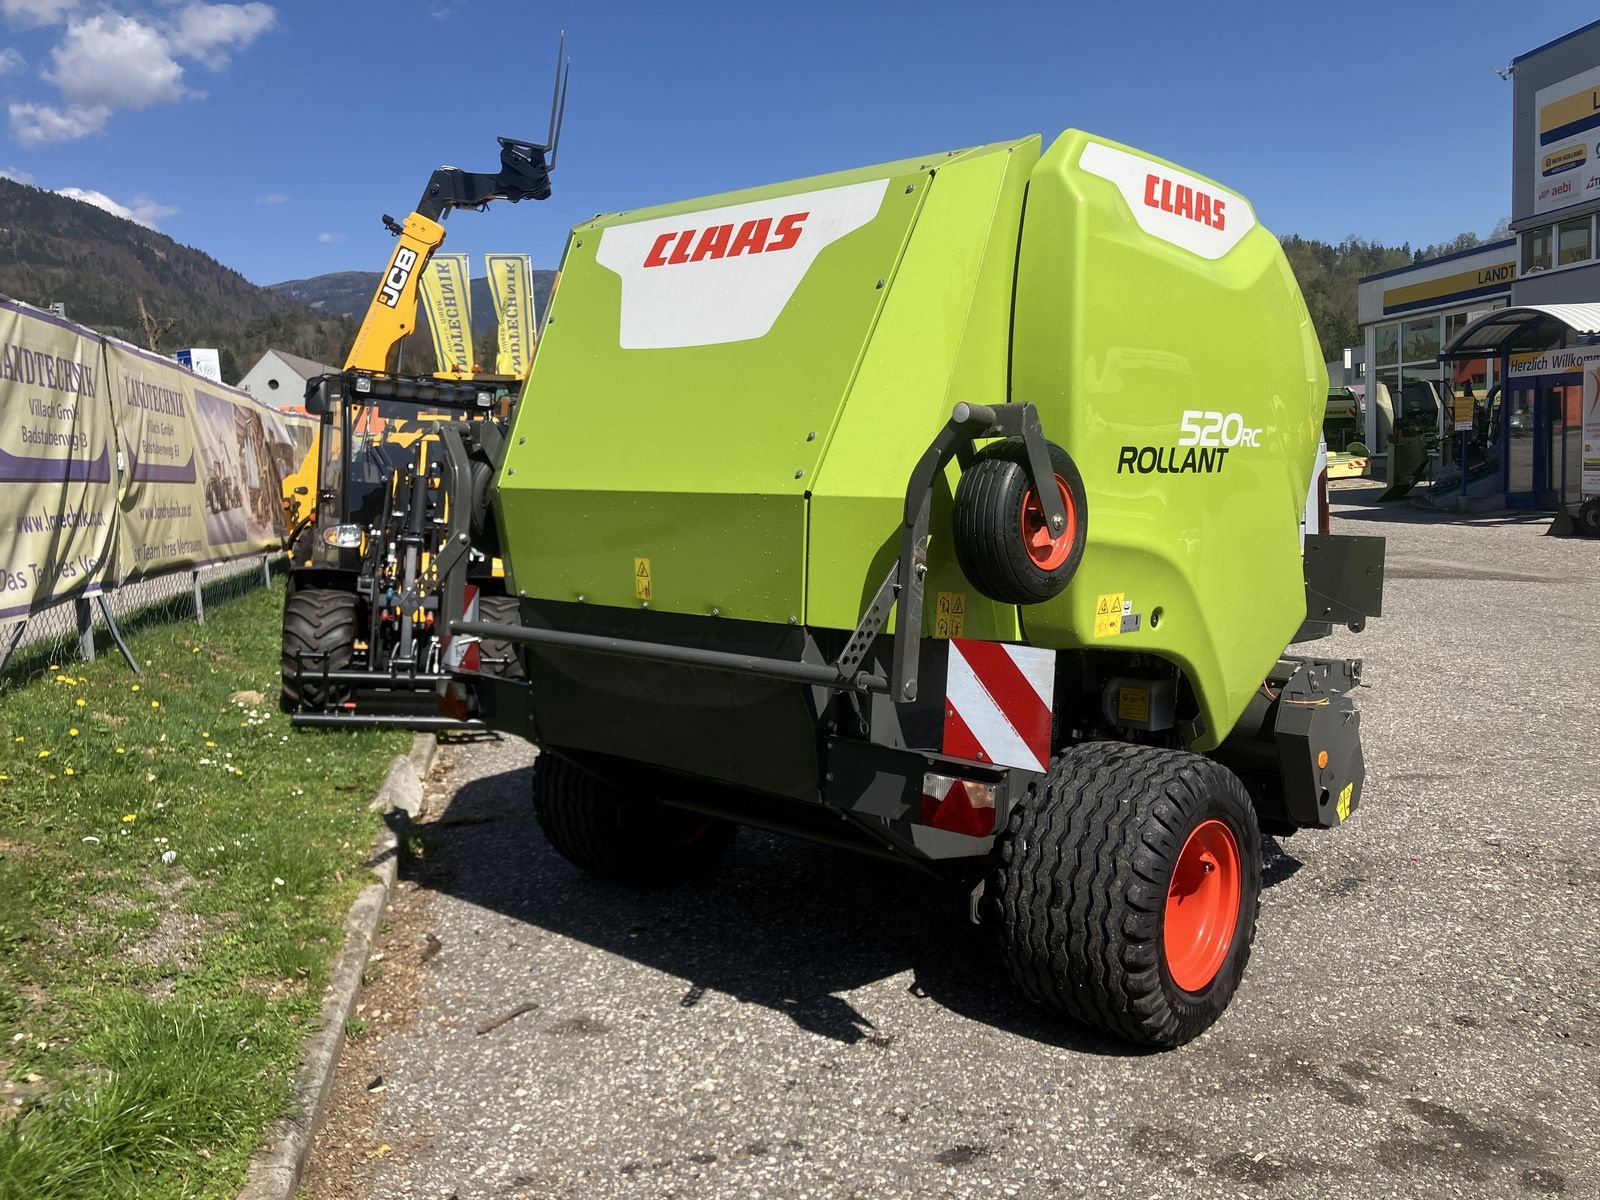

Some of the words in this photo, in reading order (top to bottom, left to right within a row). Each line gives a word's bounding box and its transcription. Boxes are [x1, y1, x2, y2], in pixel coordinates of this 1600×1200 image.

[1551, 180, 1572, 197] aebi
[1143, 173, 1226, 232] CLAAS
[643, 211, 810, 269] CLAAS
[383, 248, 418, 308] JCB
[1478, 264, 1516, 285] LANDT
[1510, 356, 1548, 374] Herzlich
[29, 398, 56, 420] Villach
[124, 376, 186, 418] LANDTECHNIK
[1116, 446, 1230, 475] ROLLANT
[143, 543, 161, 561] Team
